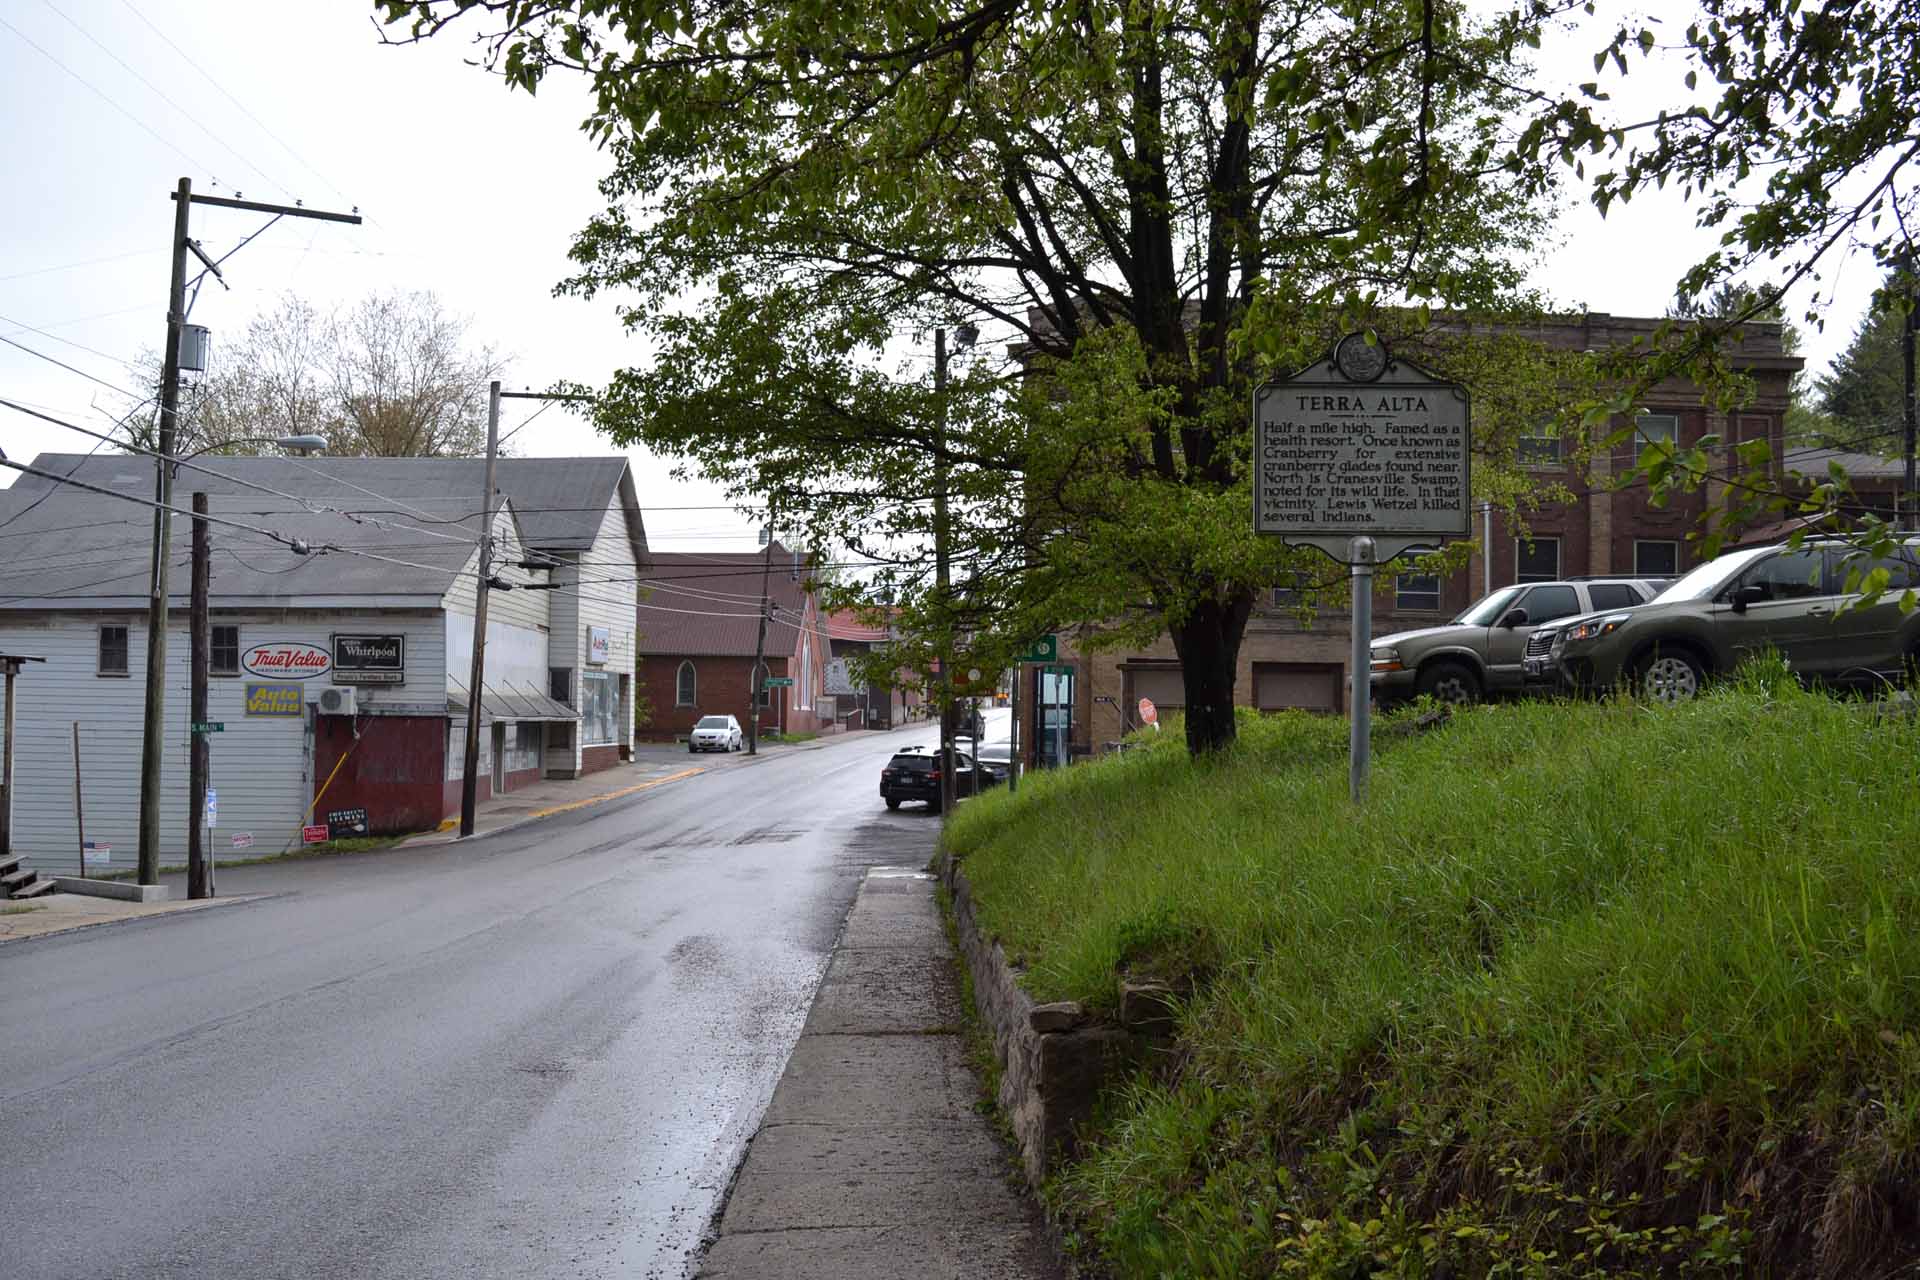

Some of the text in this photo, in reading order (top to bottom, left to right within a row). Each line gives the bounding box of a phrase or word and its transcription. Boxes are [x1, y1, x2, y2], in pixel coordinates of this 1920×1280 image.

[1296, 396, 1428, 411] TERRA ALTA
[1263, 421, 1460, 436] Half a mile high. Famed as a
[1263, 434, 1460, 447] health resort. Once known as
[1263, 446, 1460, 460] Cranberry for extensive
[1263, 460, 1460, 474] cranberry glades found near.
[1263, 472, 1303, 484] North
[1309, 473, 1321, 484] is
[1326, 472, 1405, 484] Cranesville
[1263, 485, 1460, 498] noted for its wild life. In that
[1327, 498, 1367, 510] Lewis
[1373, 499, 1417, 510] Wetzel
[1422, 498, 1461, 510] killed
[1263, 511, 1376, 522] several Indians.
[345, 645, 396, 659] Whirlpool
[250, 650, 328, 668] True Value
[255, 688, 299, 700] Auto
[247, 700, 298, 712] Value
